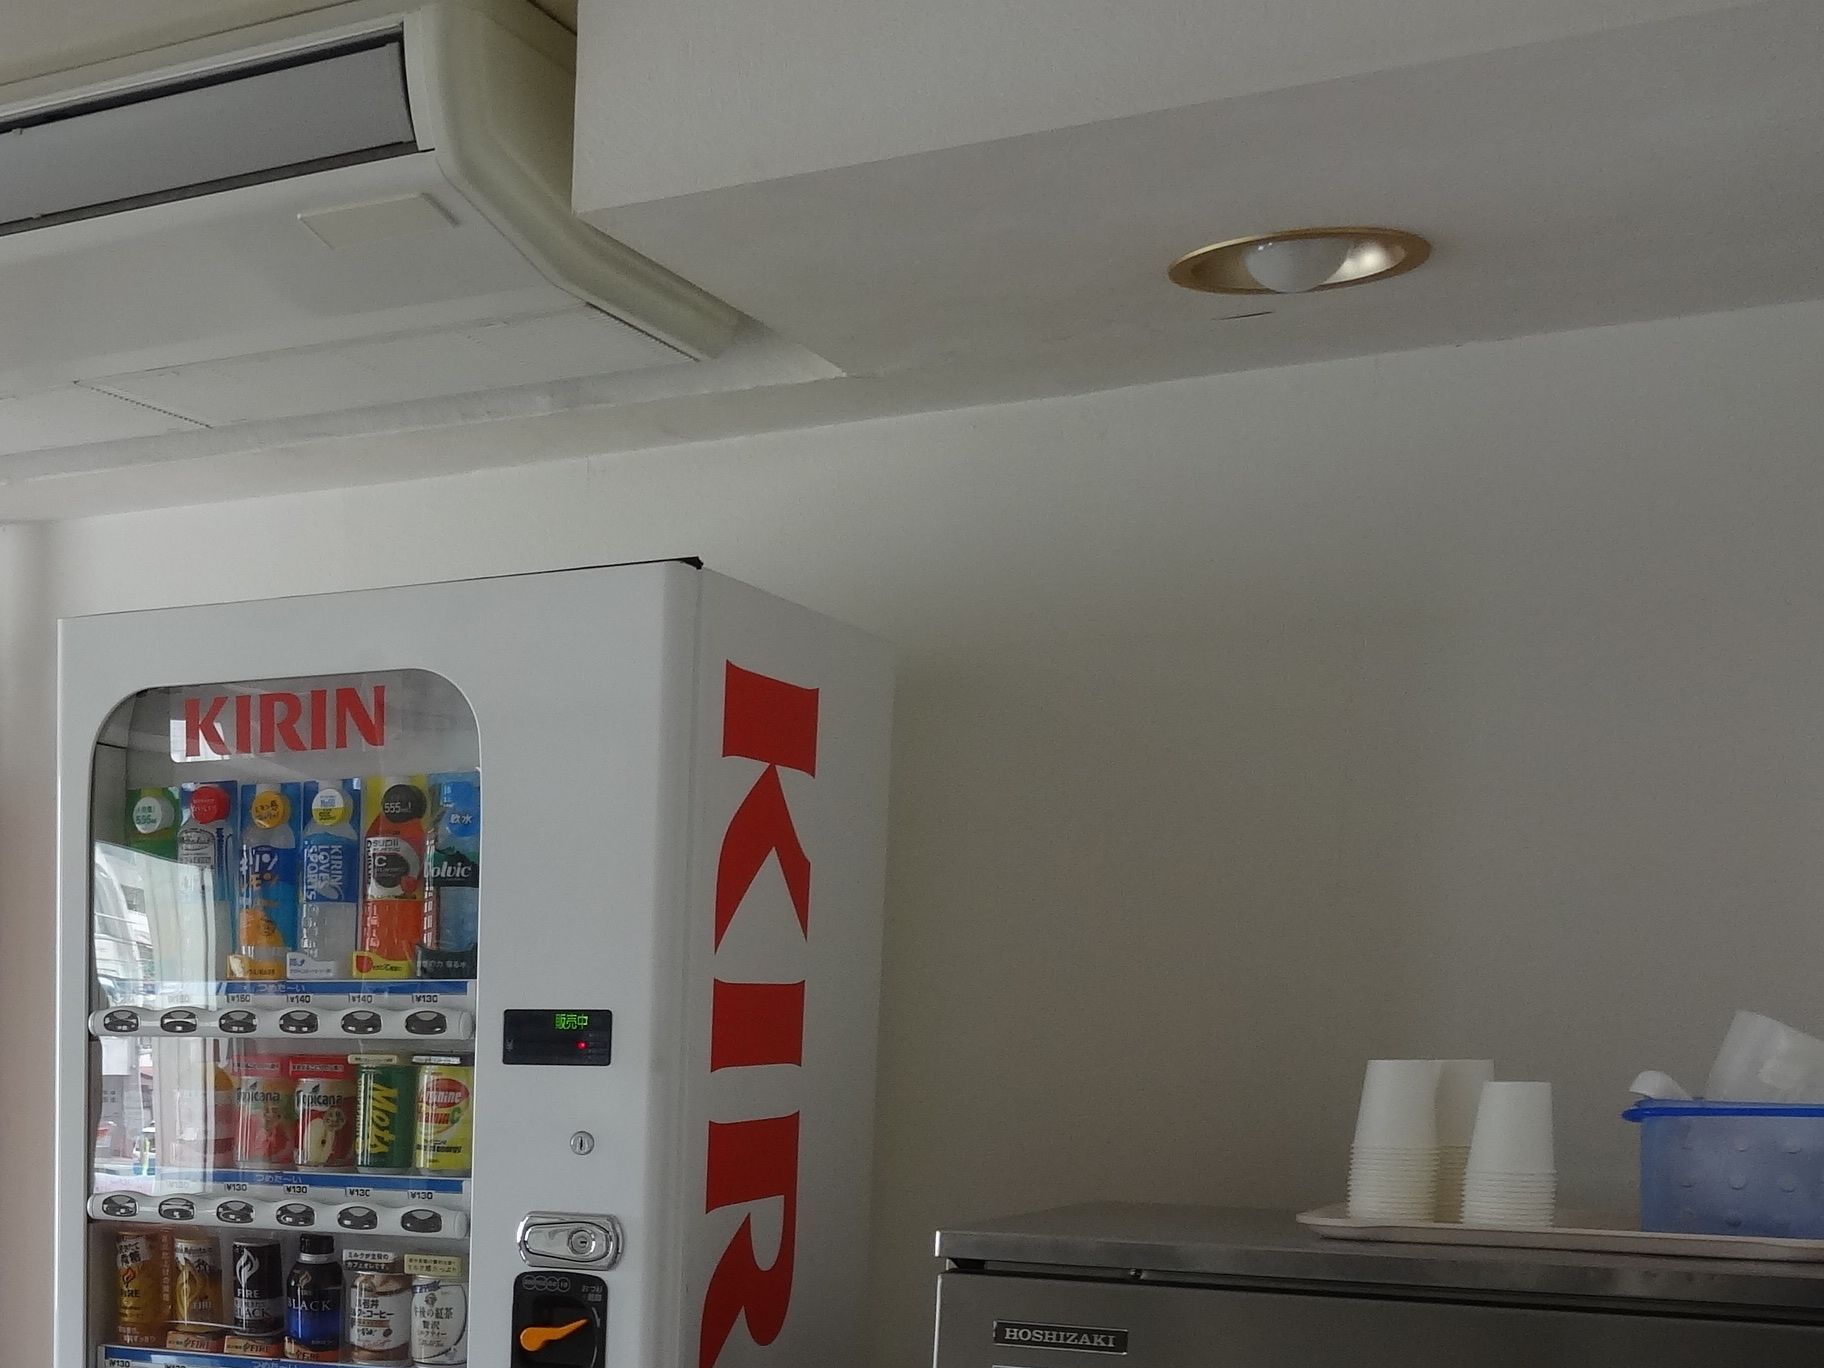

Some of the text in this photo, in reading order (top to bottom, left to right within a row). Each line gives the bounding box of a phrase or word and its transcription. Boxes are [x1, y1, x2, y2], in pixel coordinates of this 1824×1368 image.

[185, 685, 386, 757] KIRIN
[329, 845, 343, 887] KIRIN
[290, 995, 311, 1003] ¥140
[416, 995, 438, 1003] ¥130
[555, 1013, 589, 1030] 販売中
[226, 1184, 248, 1192] ¥130
[286, 1186, 308, 1194] ¥130
[410, 1191, 433, 1200] ¥130
[1004, 1327, 1116, 1348] HOSHIZAKI
